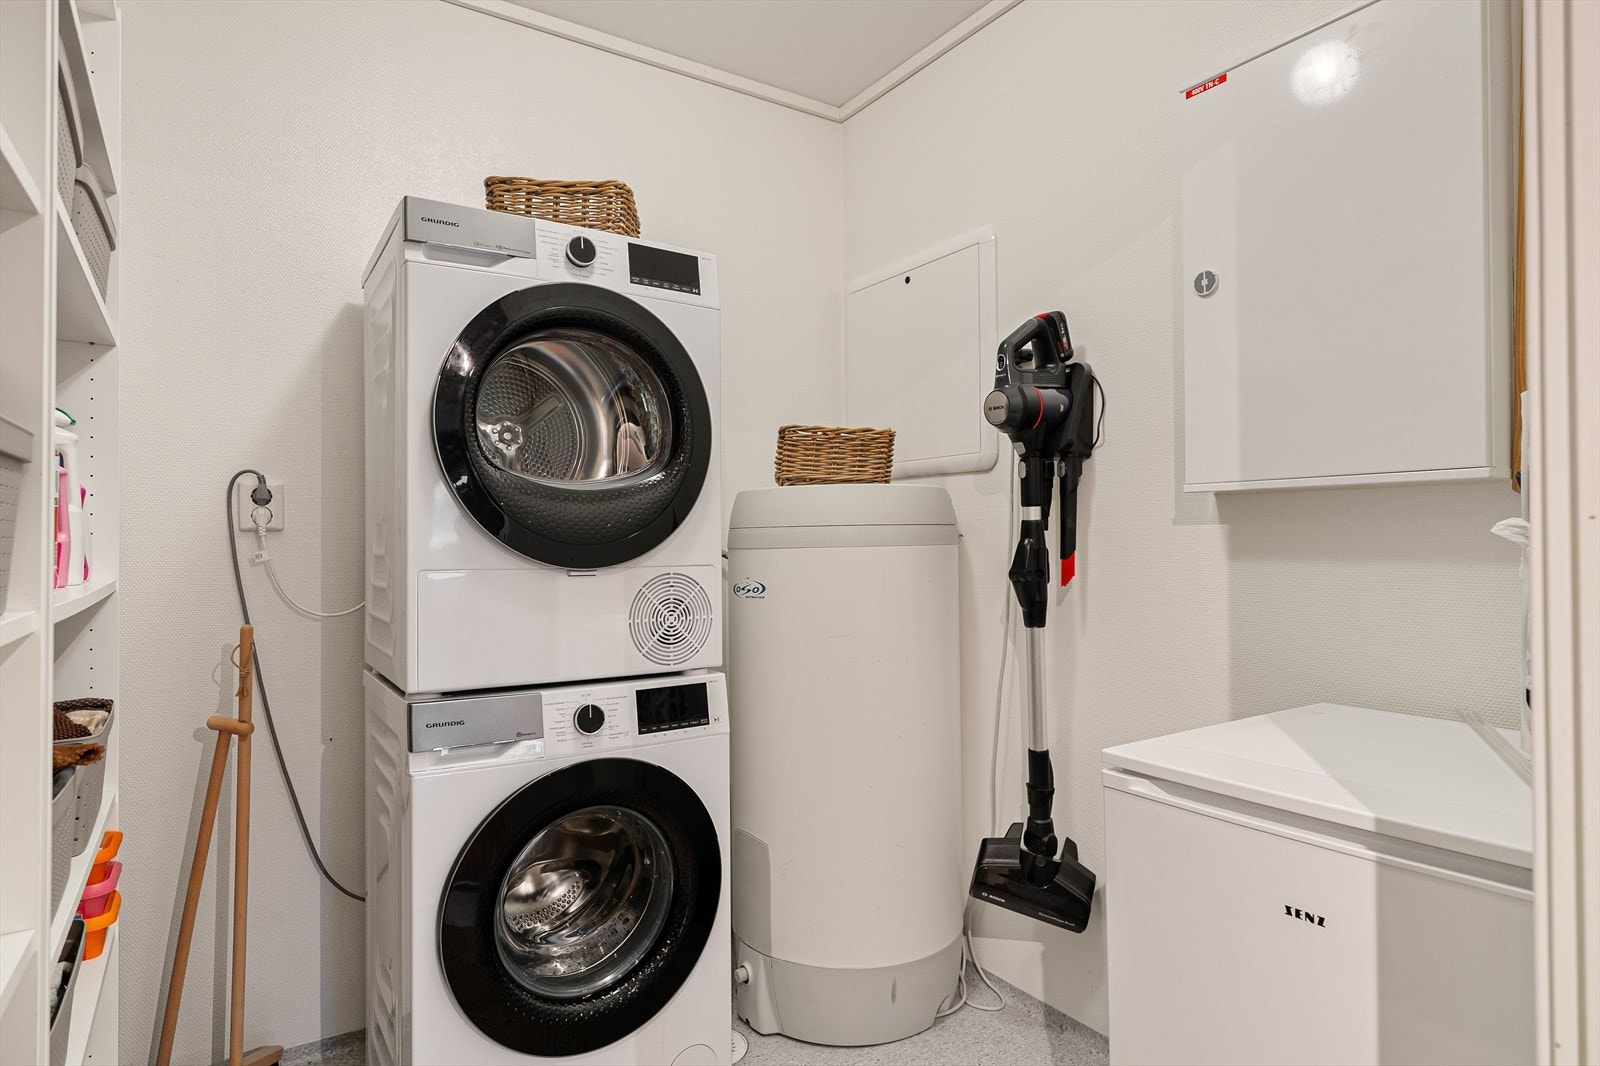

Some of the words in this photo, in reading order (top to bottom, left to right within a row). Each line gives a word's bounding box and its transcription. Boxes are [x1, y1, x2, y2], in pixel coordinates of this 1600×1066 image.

[1205, 78, 1220, 90] TN-C
[420, 216, 460, 228] GRUNDIG
[425, 720, 465, 729] GRUNDIG
[1284, 904, 1326, 928] SENZ
